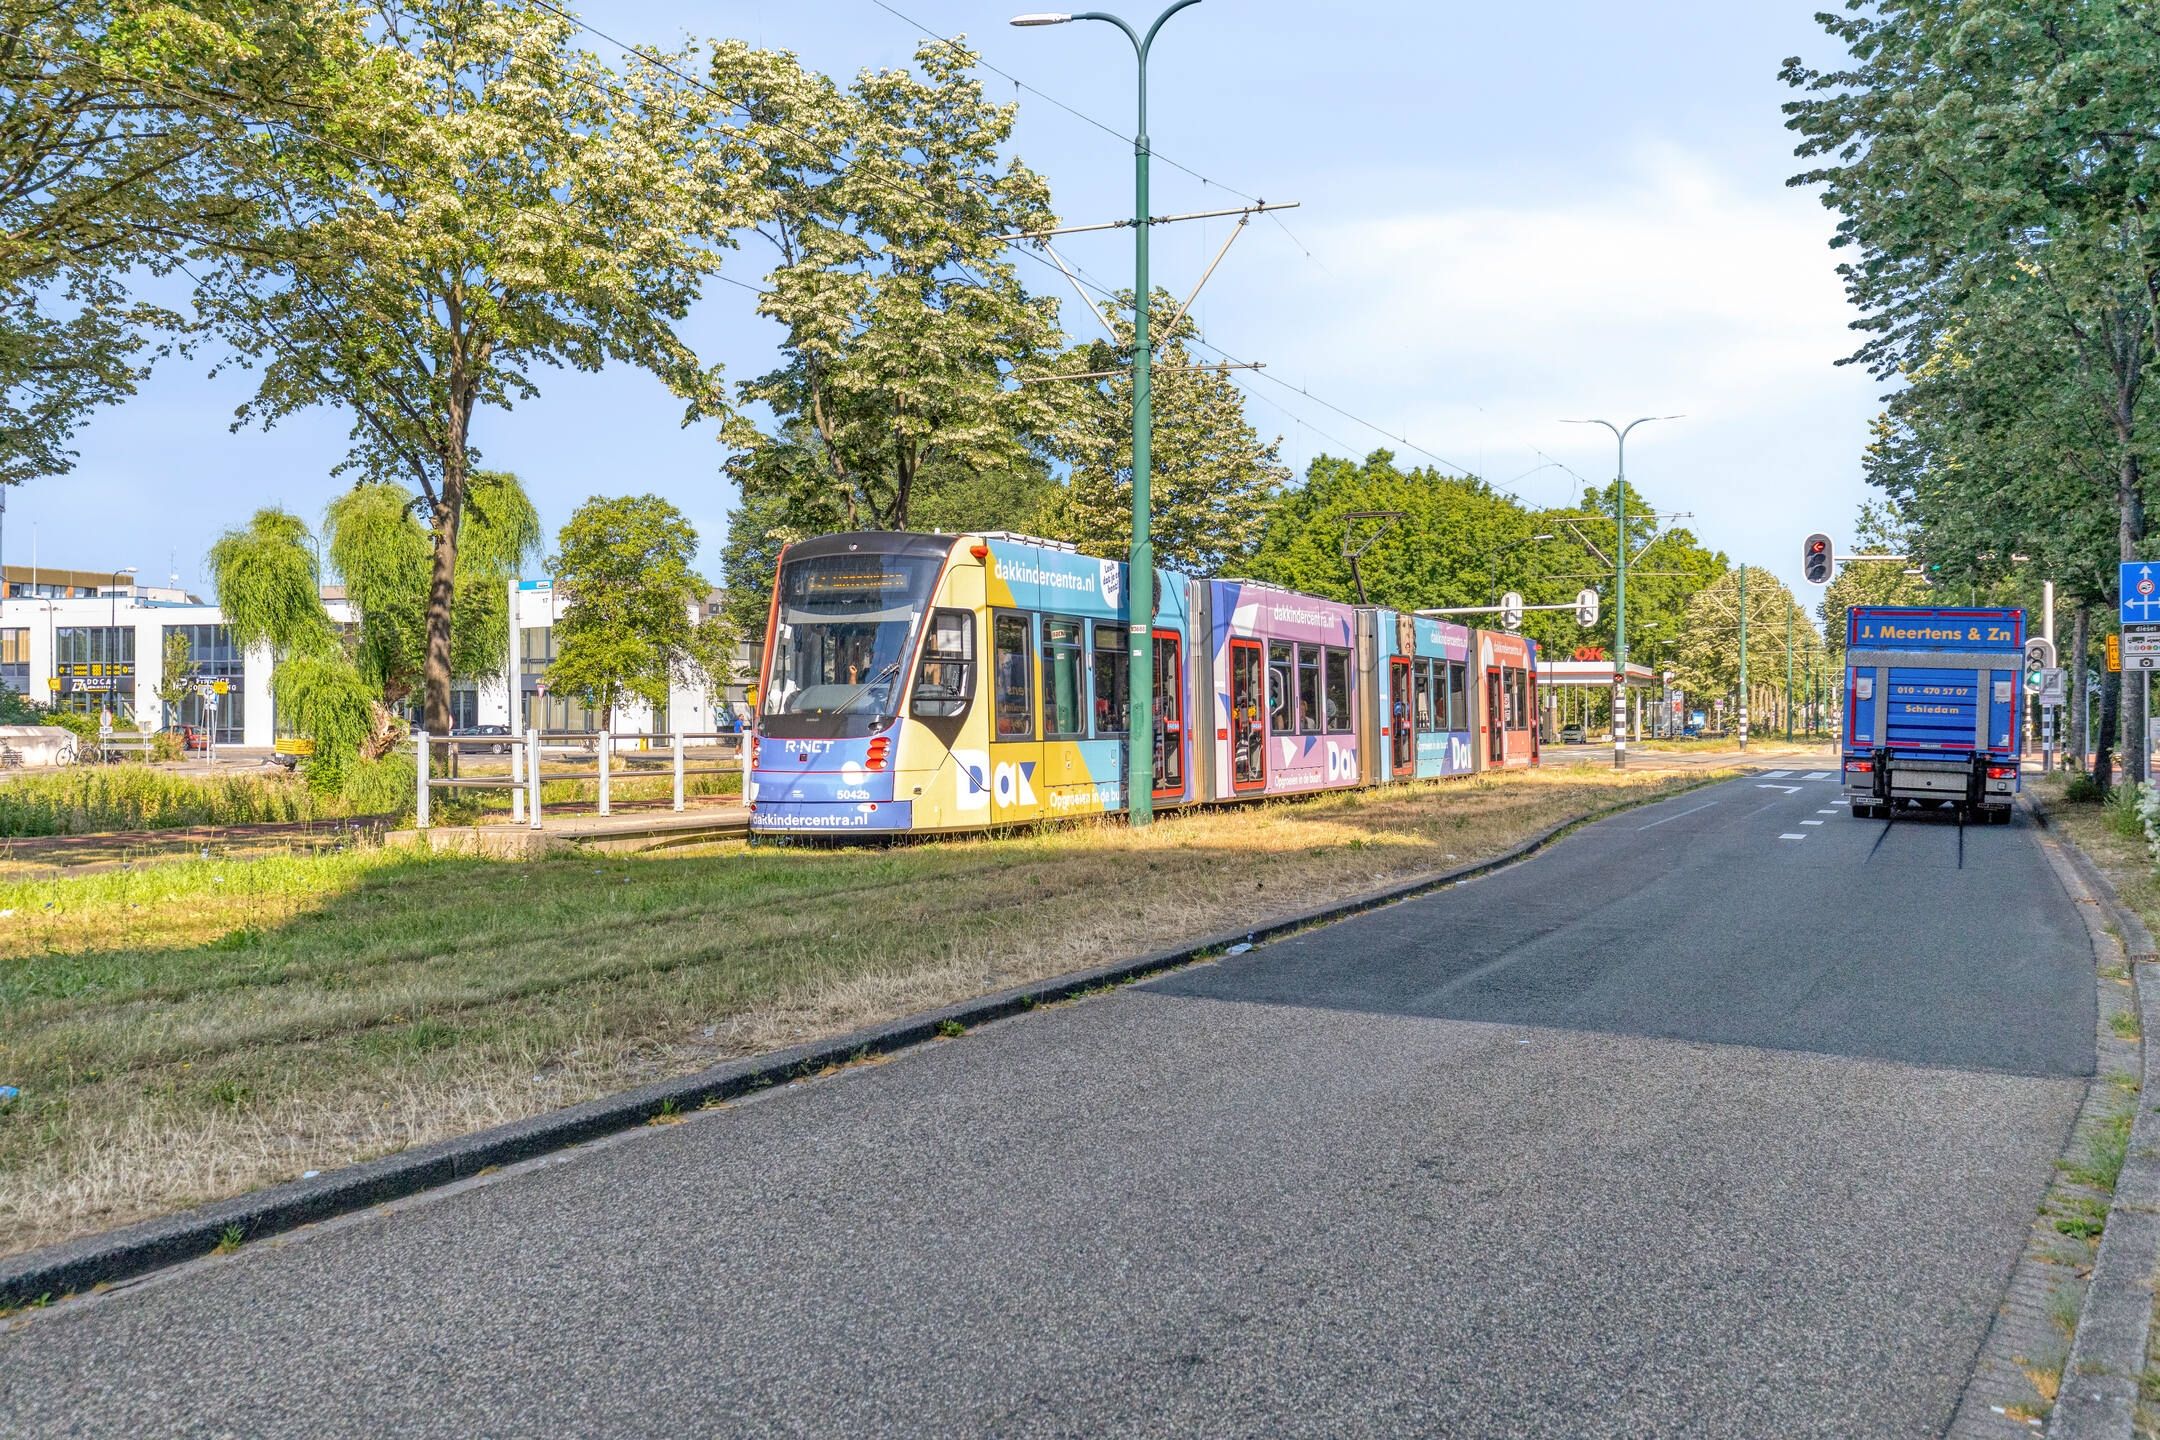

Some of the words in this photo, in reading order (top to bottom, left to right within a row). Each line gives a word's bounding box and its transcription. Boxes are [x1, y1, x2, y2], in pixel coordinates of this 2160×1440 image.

[994, 558, 1094, 592] dakkindercentra.nl
[1273, 603, 1335, 629] dakkindercentra.nl
[1861, 625, 1874, 639] J.
[1879, 625, 1962, 640] Meertens
[1967, 627, 1981, 641] &
[1987, 627, 2011, 641] Zn
[1575, 646, 1605, 661] OK
[1897, 686, 1915, 694] 010
[1923, 687, 1940, 695] 470
[1956, 688, 1968, 696] 07
[1905, 703, 1959, 714] Schiedam
[836, 789, 870, 800] 5042b
[1100, 787, 1110, 802] de
[752, 812, 868, 826] dakkindercentra.nl
